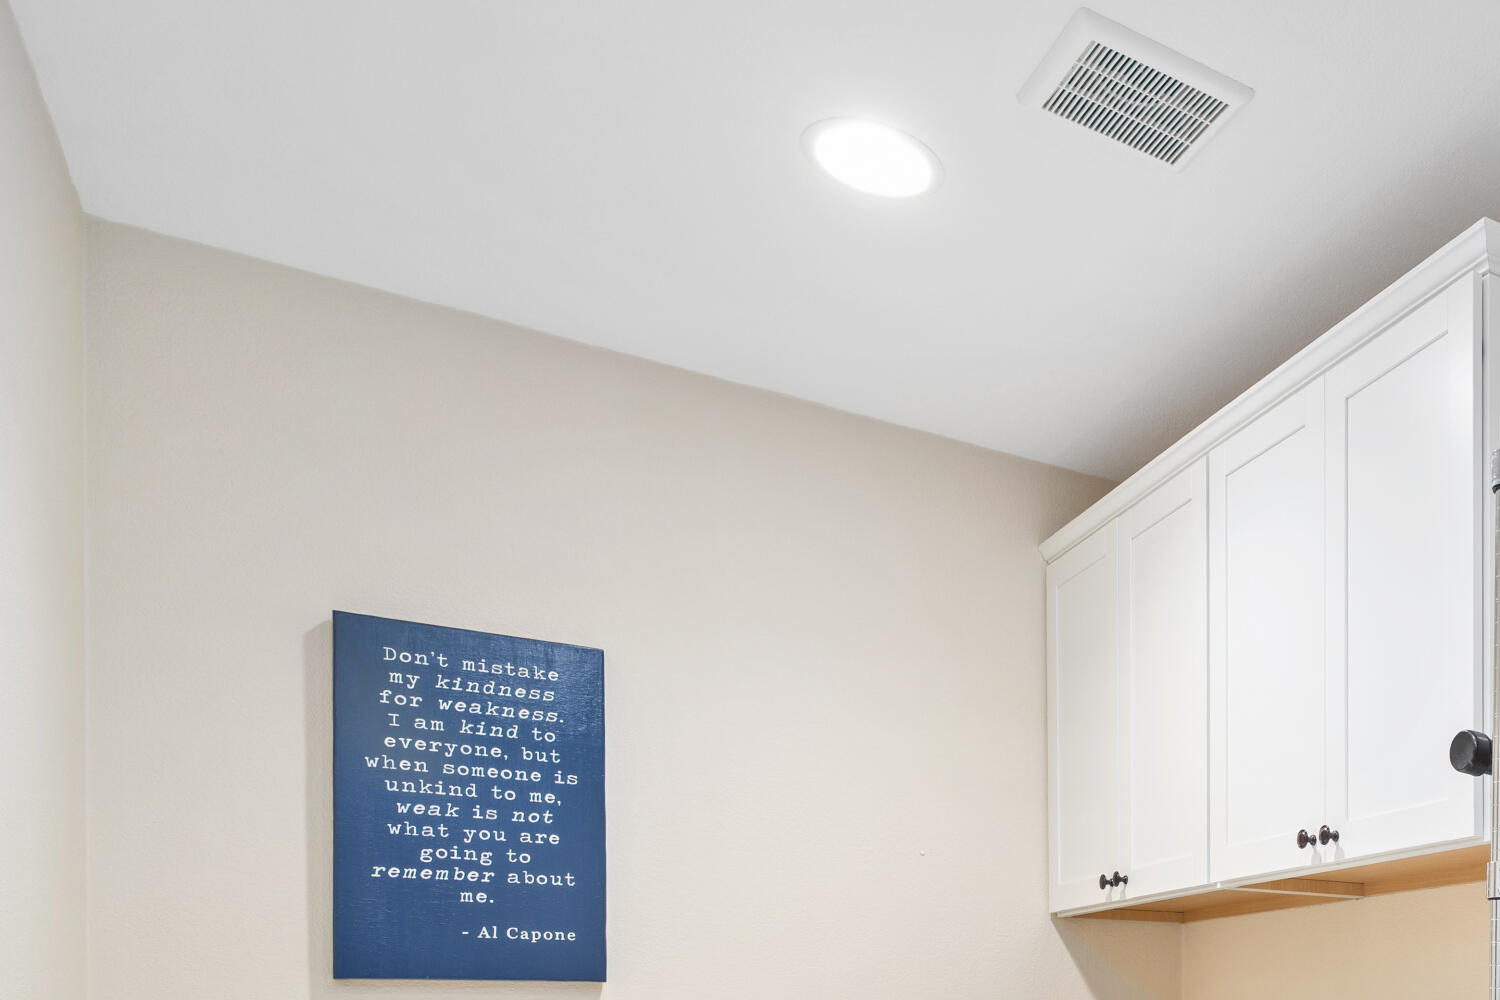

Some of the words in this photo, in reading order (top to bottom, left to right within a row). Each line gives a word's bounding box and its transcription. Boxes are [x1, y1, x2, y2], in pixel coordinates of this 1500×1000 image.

[382, 646, 449, 668] Don't
[461, 658, 559, 682] mistake
[388, 671, 421, 690] my
[434, 675, 556, 702] kindness
[379, 689, 423, 708] for
[438, 698, 564, 724] weakness.
[387, 712, 401, 727] I
[413, 717, 445, 732] am
[458, 719, 519, 739] kind
[531, 727, 556, 743] to
[383, 736, 508, 761] everyone,
[520, 746, 561, 764] but
[364, 754, 429, 773] when
[442, 763, 542, 783] someone
[553, 770, 578, 786] is
[384, 778, 479, 798] unkind
[490, 784, 517, 801] to
[528, 791, 562, 807] me,
[396, 802, 460, 818] weak
[472, 804, 498, 821] is
[511, 809, 554, 825] not
[386, 820, 450, 838] what
[462, 828, 507, 844] you
[519, 831, 561, 845] are
[419, 845, 493, 867] going
[505, 848, 531, 864] to
[370, 865, 496, 883] remember
[506, 870, 576, 887] about
[459, 891, 494, 904] me.
[476, 925, 498, 939] Al
[505, 926, 577, 944] Capone
